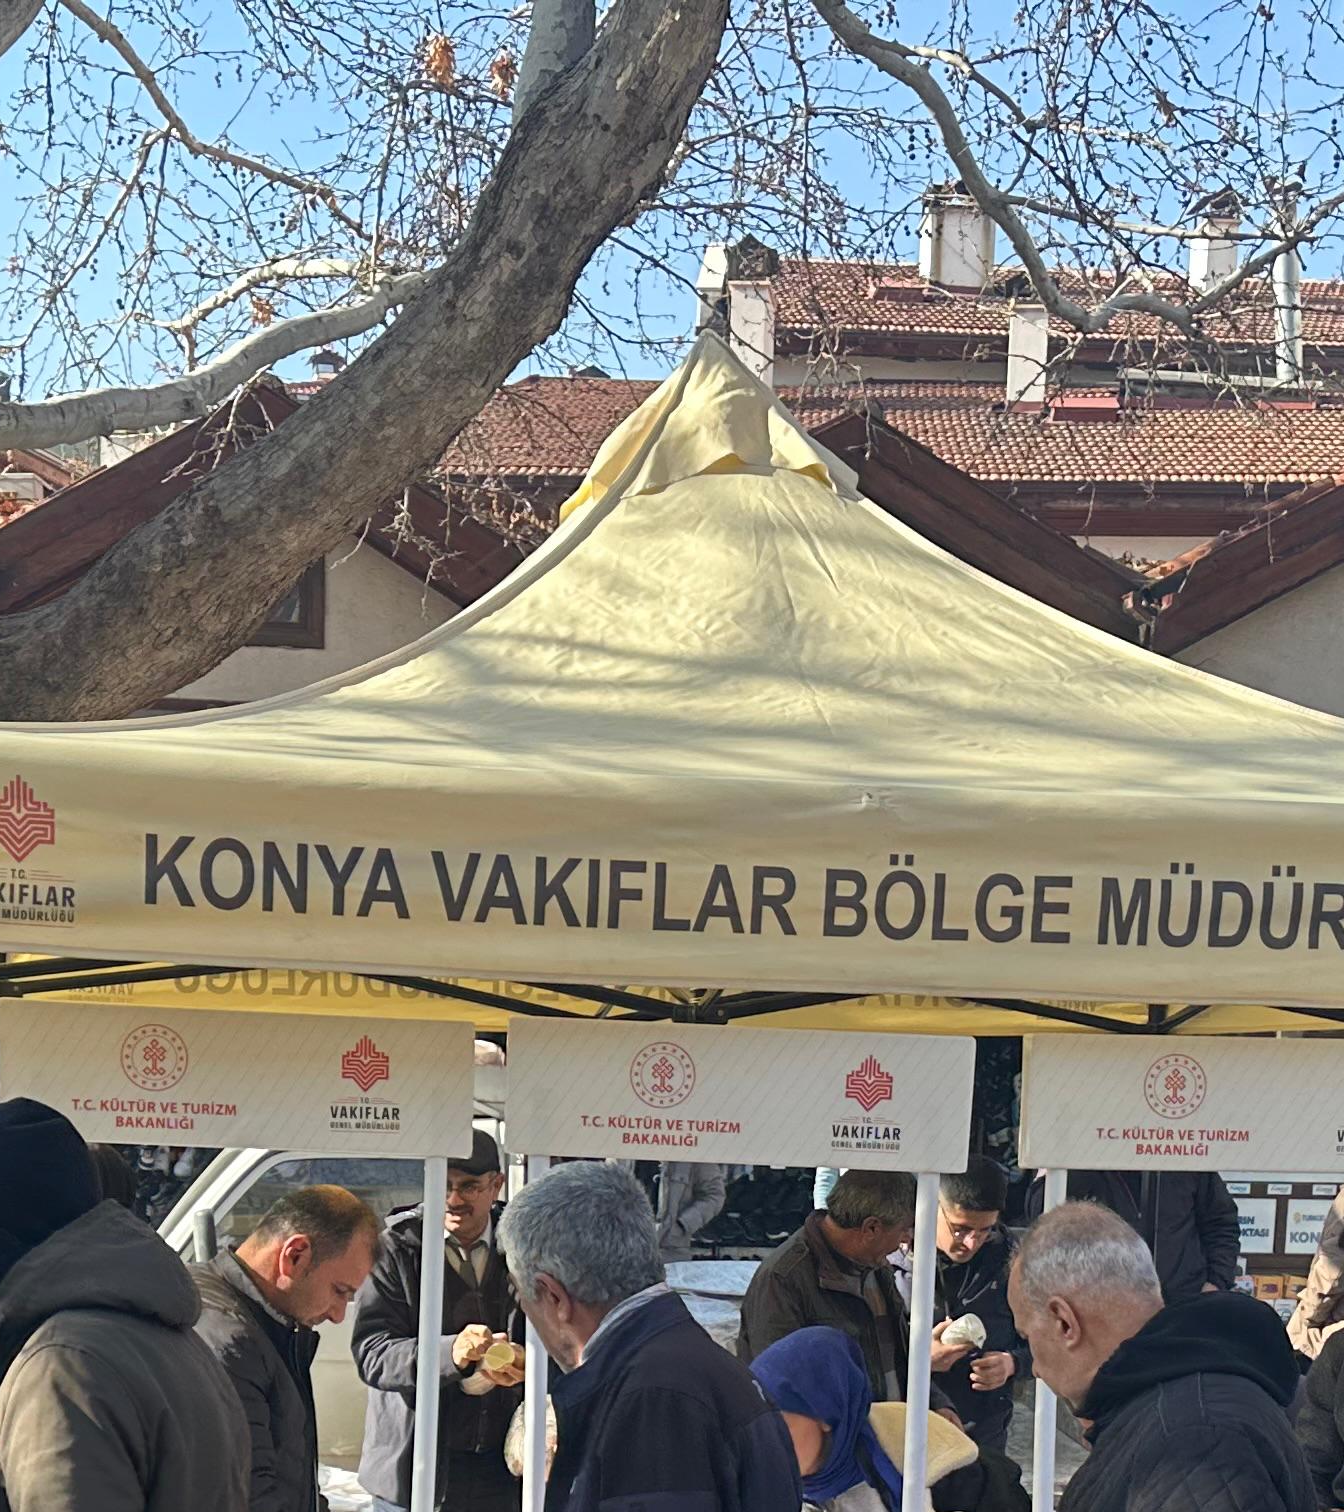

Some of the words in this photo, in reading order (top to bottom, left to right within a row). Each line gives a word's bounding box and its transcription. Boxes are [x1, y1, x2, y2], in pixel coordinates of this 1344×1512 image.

[10, 868, 28, 880] T.C.
[144, 833, 411, 920] KONYA
[430, 850, 798, 936] VAKIFLAR
[821, 854, 1074, 944] BÖLGE
[1, 905, 75, 923] MÜDÜRLÜĞÜ
[71, 1099, 97, 1112] T.C.
[100, 1098, 156, 1114] KÜLTÜR
[160, 1103, 178, 1114] VE
[181, 1101, 238, 1118] TURİZM
[330, 1105, 401, 1121] VAKIFLAR
[115, 1115, 195, 1131] BAKANLIĞI
[580, 1115, 605, 1128] T.C.
[608, 1113, 664, 1131] KÜLTÜR
[666, 1119, 685, 1132] VE
[688, 1117, 741, 1134] TURİZM
[622, 1130, 699, 1147] BAKANLIĞI
[831, 1124, 902, 1141] VAKIFLAR
[1096, 1127, 1119, 1141] T.C.
[1122, 1126, 1175, 1142] KÜLTÜR
[1178, 1129, 1195, 1142] VE
[1199, 1127, 1250, 1143] TURİZM
[1135, 1142, 1210, 1157] BAKANLIĞI
[1241, 1228, 1270, 1238] KTASI
[1289, 1231, 1321, 1244] KON
